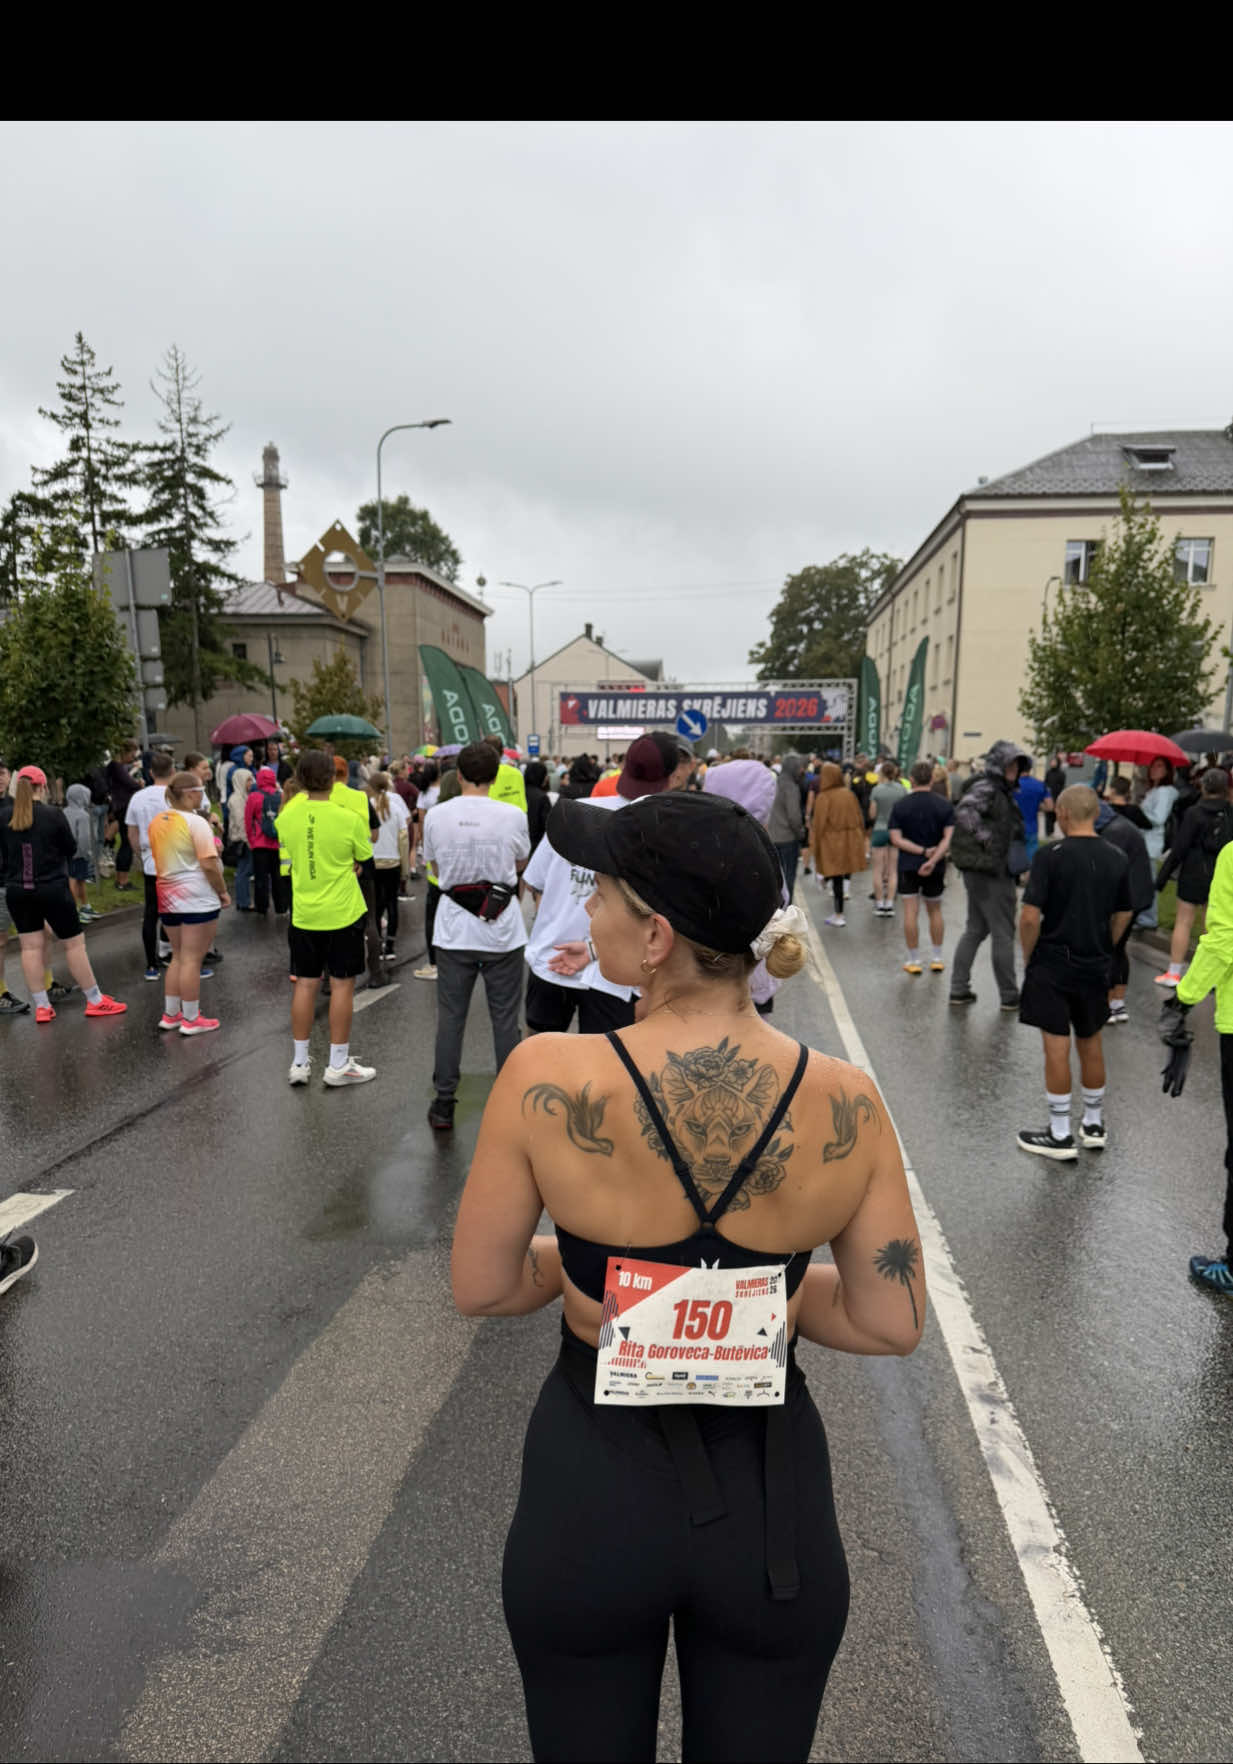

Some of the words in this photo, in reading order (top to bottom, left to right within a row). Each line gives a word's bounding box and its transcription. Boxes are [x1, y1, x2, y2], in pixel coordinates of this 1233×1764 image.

[588, 699, 678, 719] VALMIERAS
[774, 698, 819, 719] 2026
[619, 1271, 632, 1288] 10
[632, 1273, 653, 1291] km
[672, 1299, 733, 1341] 150
[618, 1340, 645, 1359] Rita
